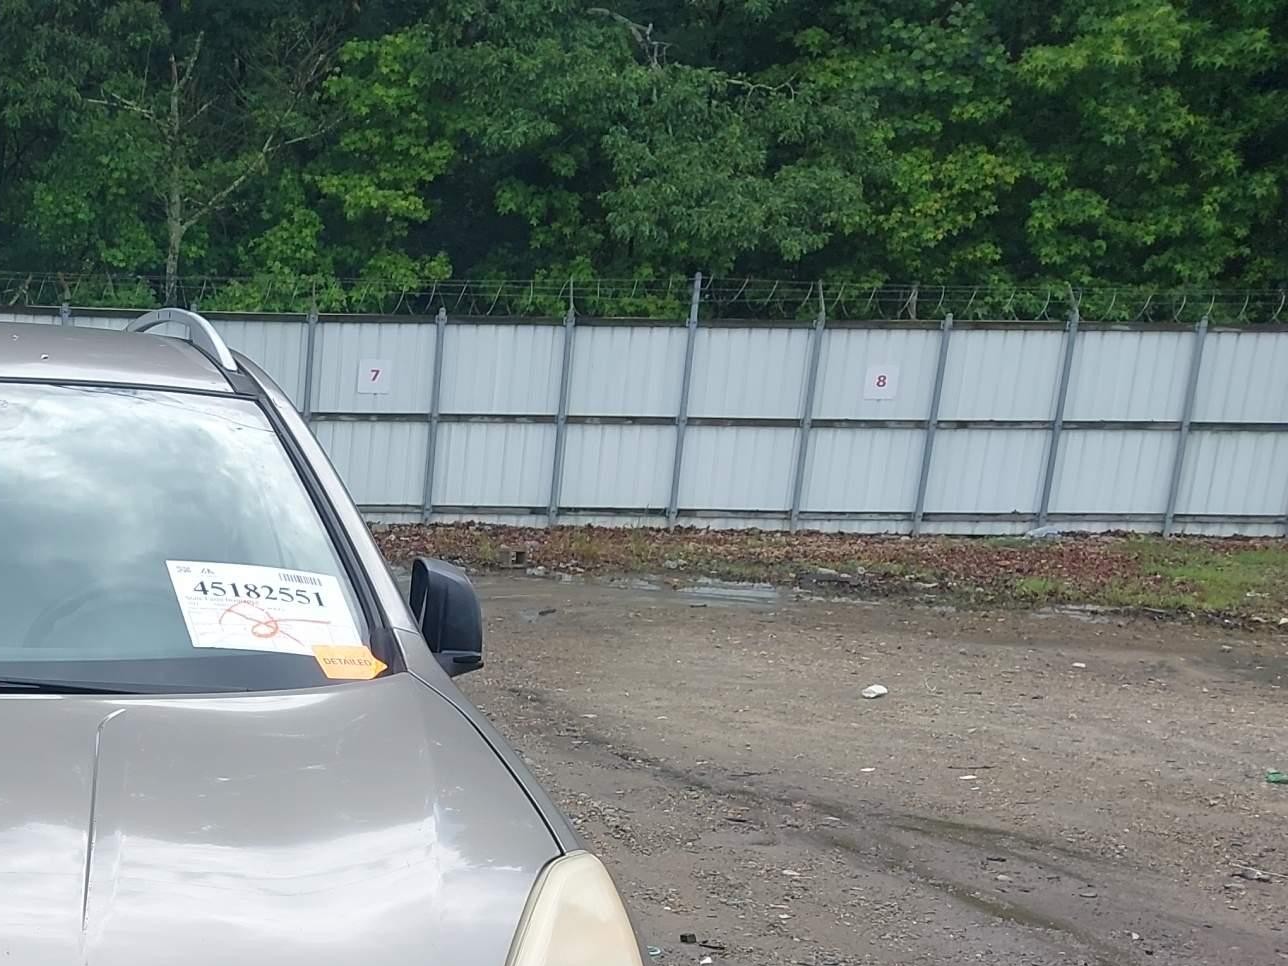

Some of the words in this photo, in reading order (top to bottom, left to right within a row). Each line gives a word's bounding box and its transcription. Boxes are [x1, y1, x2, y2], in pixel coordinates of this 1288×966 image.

[370, 369, 381, 382] 7
[875, 374, 887, 388] 8
[193, 580, 327, 608] 45182551
[322, 657, 372, 667] DETAILED
